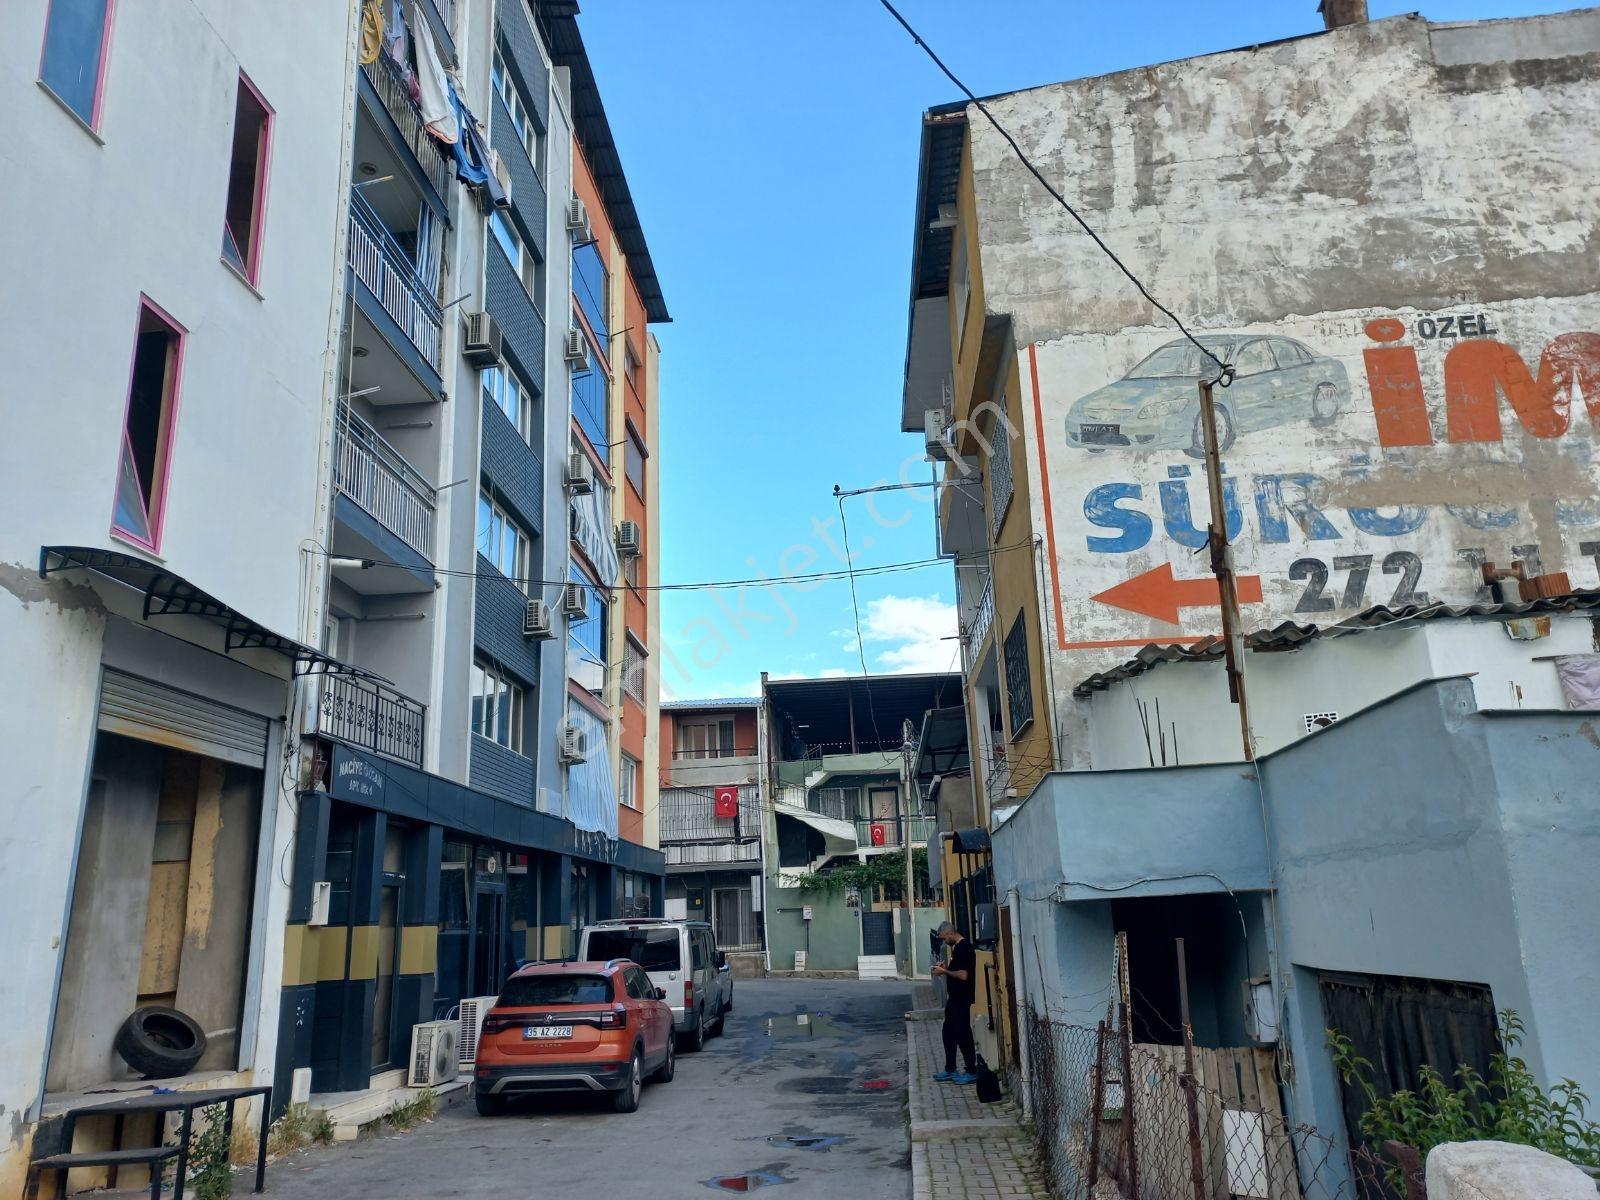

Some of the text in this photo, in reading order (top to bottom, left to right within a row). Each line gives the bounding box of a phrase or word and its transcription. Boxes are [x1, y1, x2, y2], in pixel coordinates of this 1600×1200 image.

[1417, 311, 1497, 339] ÖZEL
[1289, 551, 1430, 613] 272
[528, 1027, 537, 1037] 35
[540, 1027, 550, 1036] AZ
